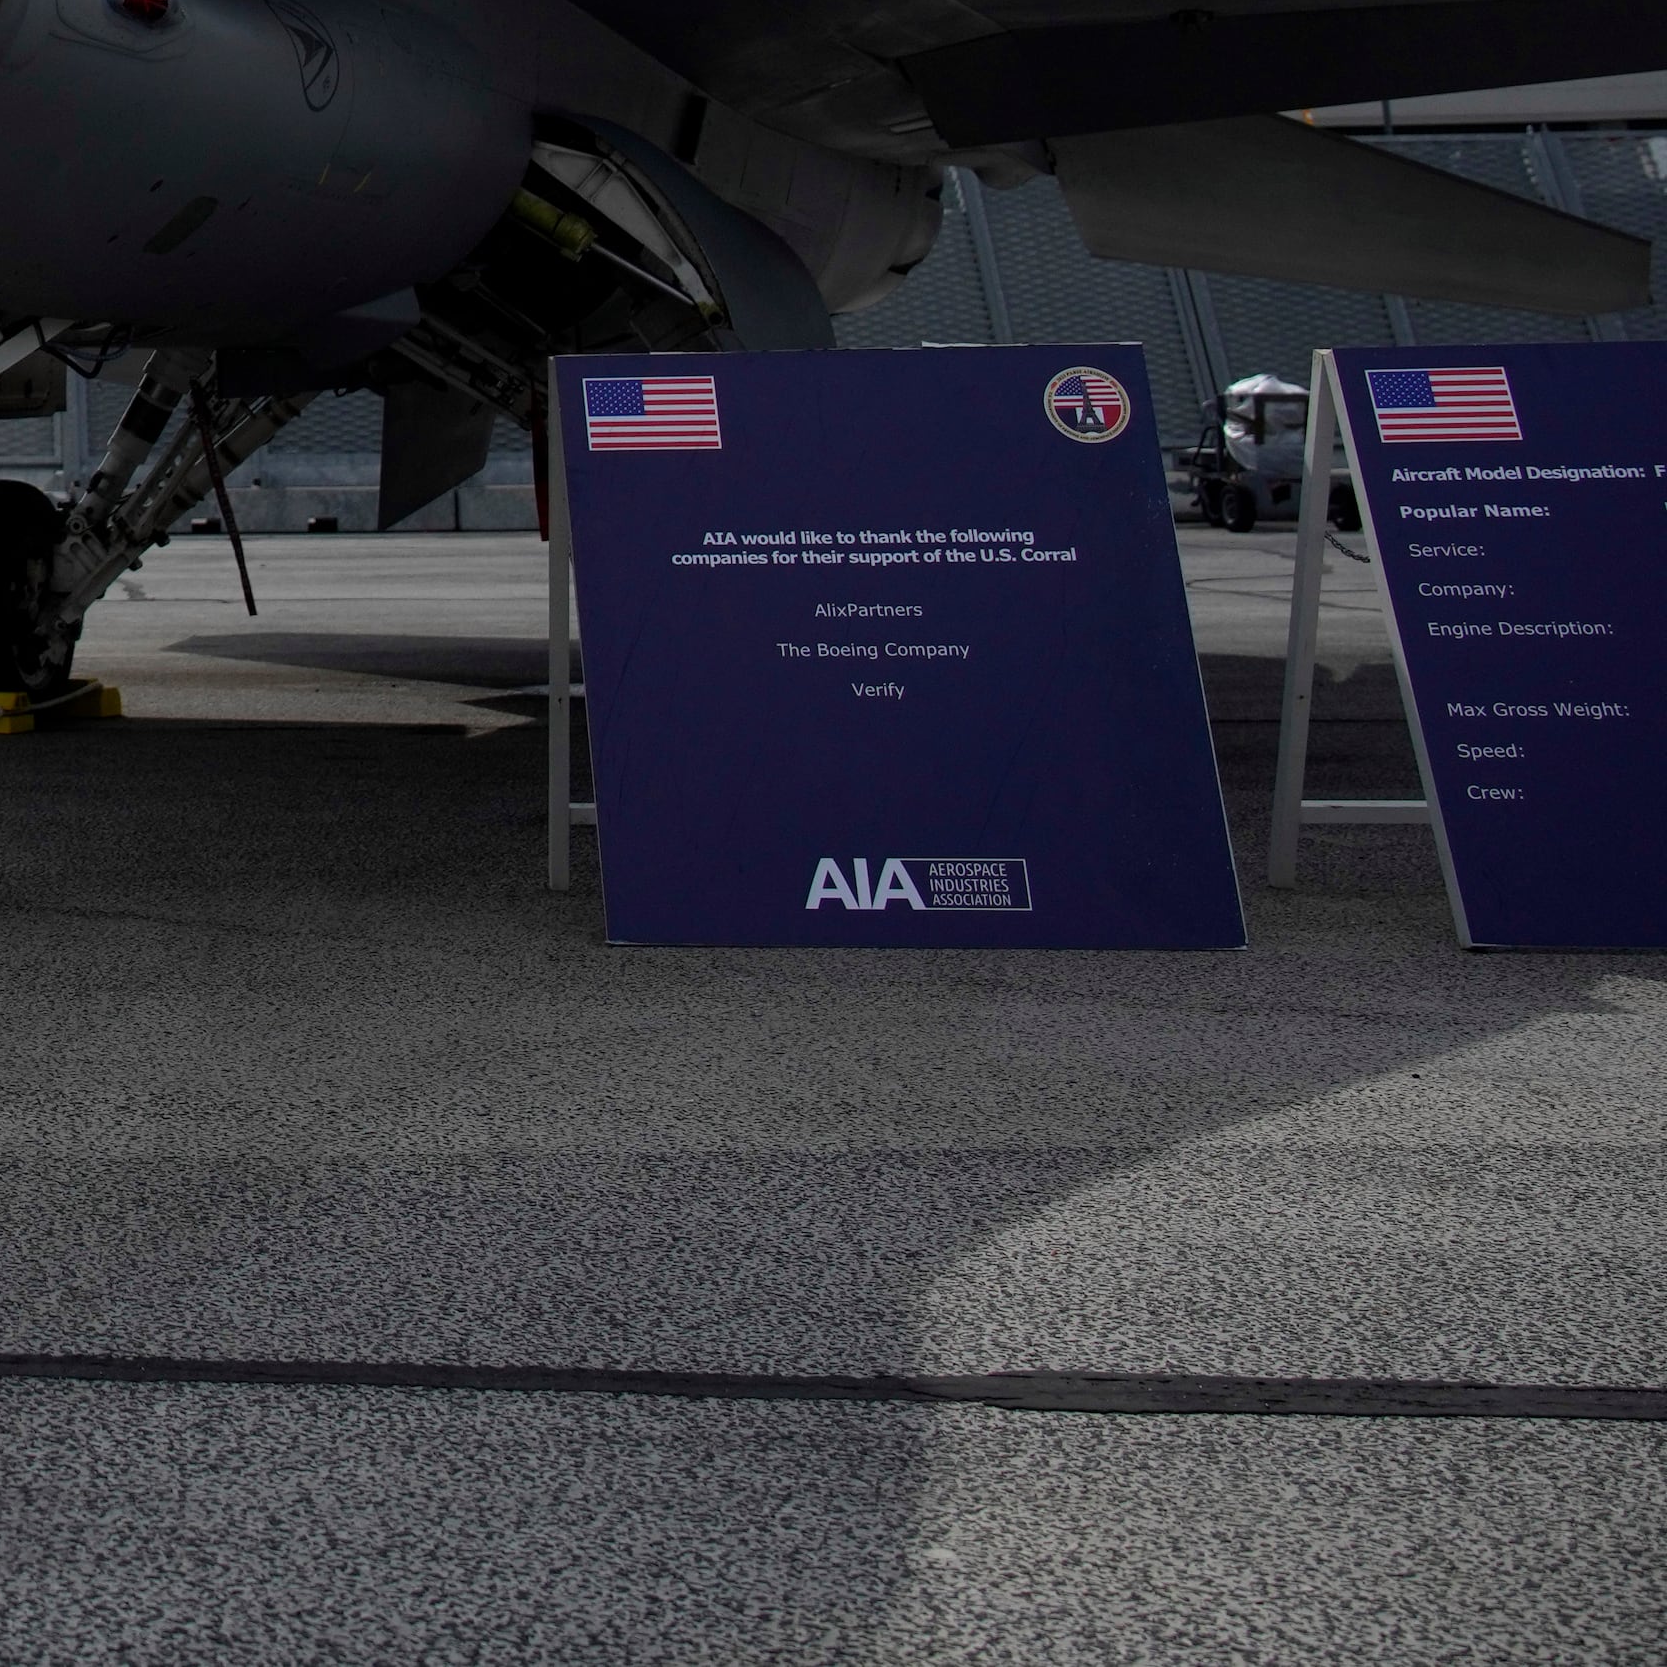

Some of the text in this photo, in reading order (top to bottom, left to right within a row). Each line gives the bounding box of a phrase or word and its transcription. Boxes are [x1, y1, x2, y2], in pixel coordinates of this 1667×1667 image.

[1391, 467, 1463, 482] Aircraft
[1465, 466, 1522, 480] Model
[1525, 465, 1646, 482] Designation:
[1399, 504, 1550, 521] Popular Name:
[703, 528, 1034, 545] AIA would like to thank the following
[671, 547, 1076, 568] companies for their support of the U.S. Corral
[1408, 543, 1485, 557] Service:
[1418, 582, 1515, 599] Company:
[814, 603, 923, 617] AlixPartners
[1427, 620, 1614, 639] Engine Description:
[776, 642, 970, 659] The Boeing Company
[851, 682, 905, 700] Verify
[1447, 702, 1630, 720] Max Gross Weight:
[1456, 743, 1525, 761] Speed:
[1466, 785, 1524, 800] Crew:
[929, 863, 1007, 877] AEROSPACE
[805, 858, 927, 910] AIA
[930, 879, 1009, 892] INDUSTRIES
[932, 894, 1012, 907] ASSOCIATION
